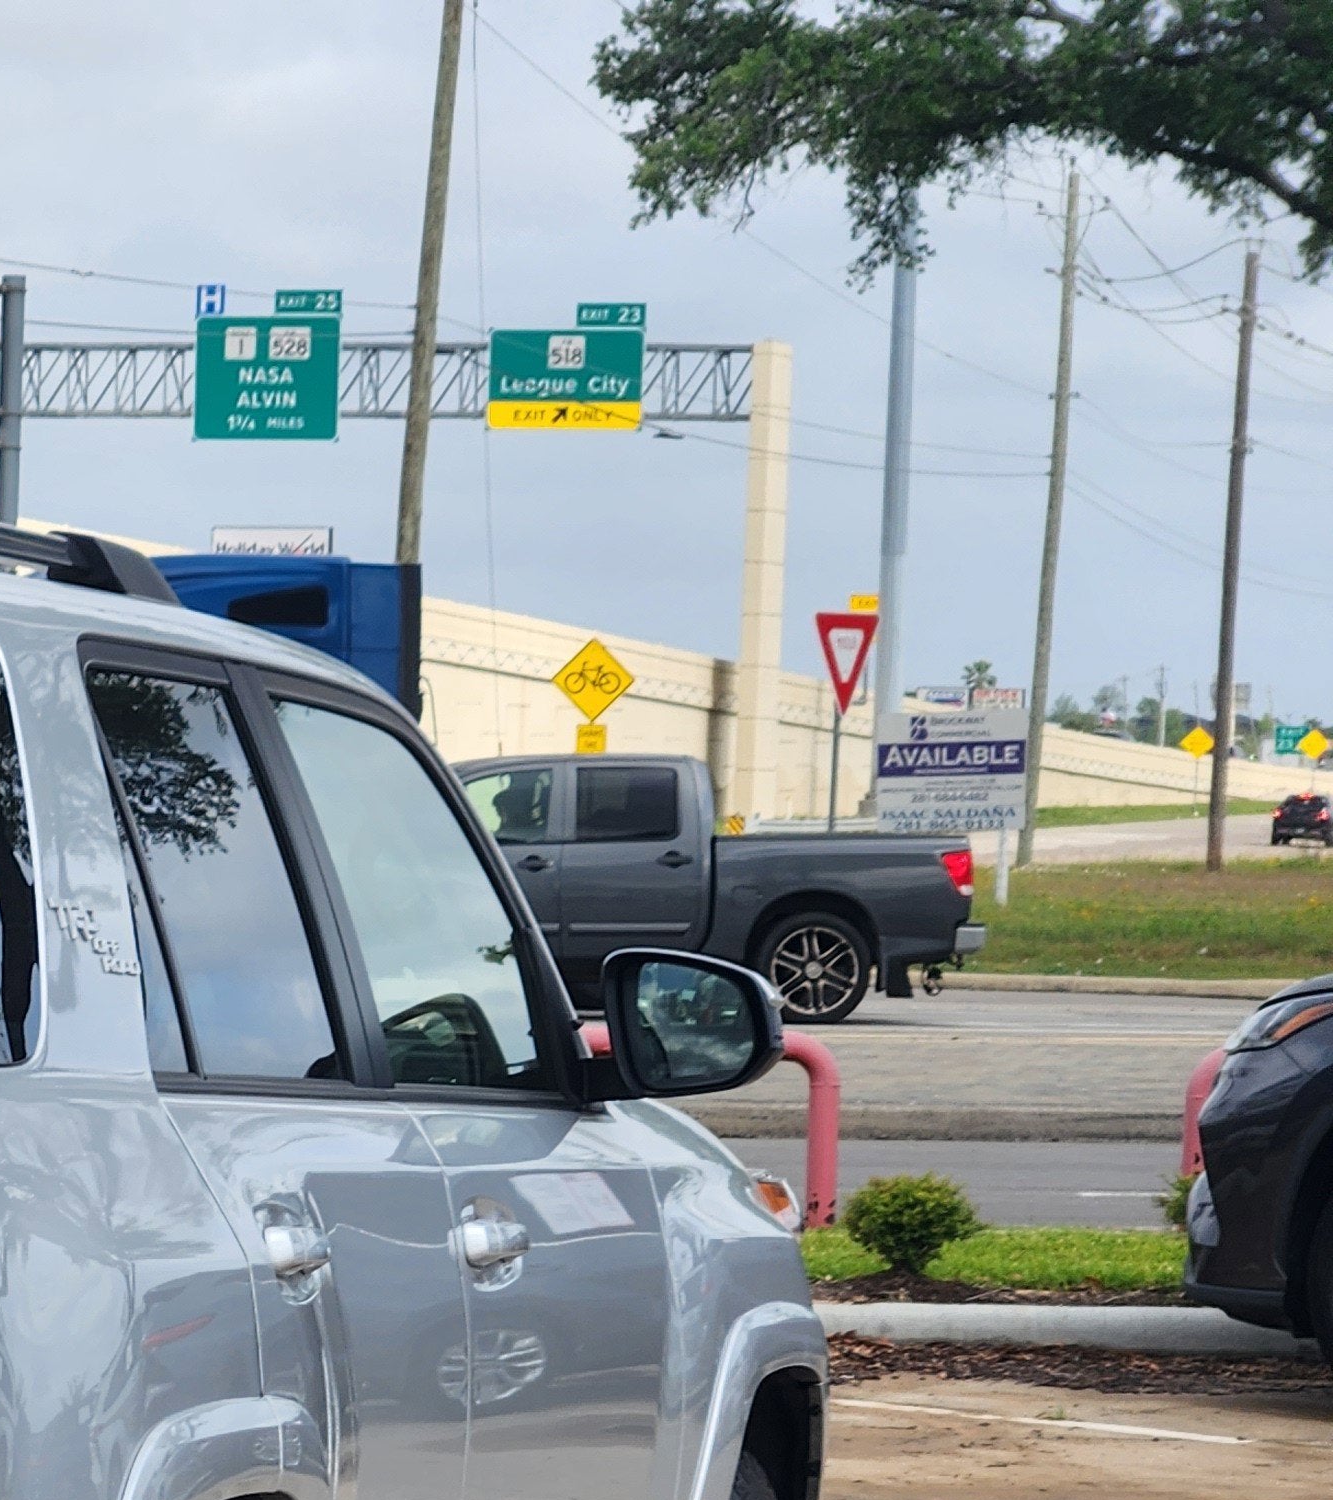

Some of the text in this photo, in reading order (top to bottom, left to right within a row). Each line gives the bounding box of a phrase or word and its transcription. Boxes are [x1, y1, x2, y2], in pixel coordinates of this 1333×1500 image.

[278, 292, 338, 310] EXIT 25
[581, 306, 641, 323] EXIT 23
[272, 337, 309, 357] 528
[551, 347, 583, 366] 518
[238, 366, 294, 384] NASA
[499, 375, 631, 400] League City
[236, 390, 297, 409] ALVIN
[266, 416, 306, 430] MILES
[513, 408, 614, 423] EXIT ONLY
[883, 744, 1021, 768] AVAILABLE
